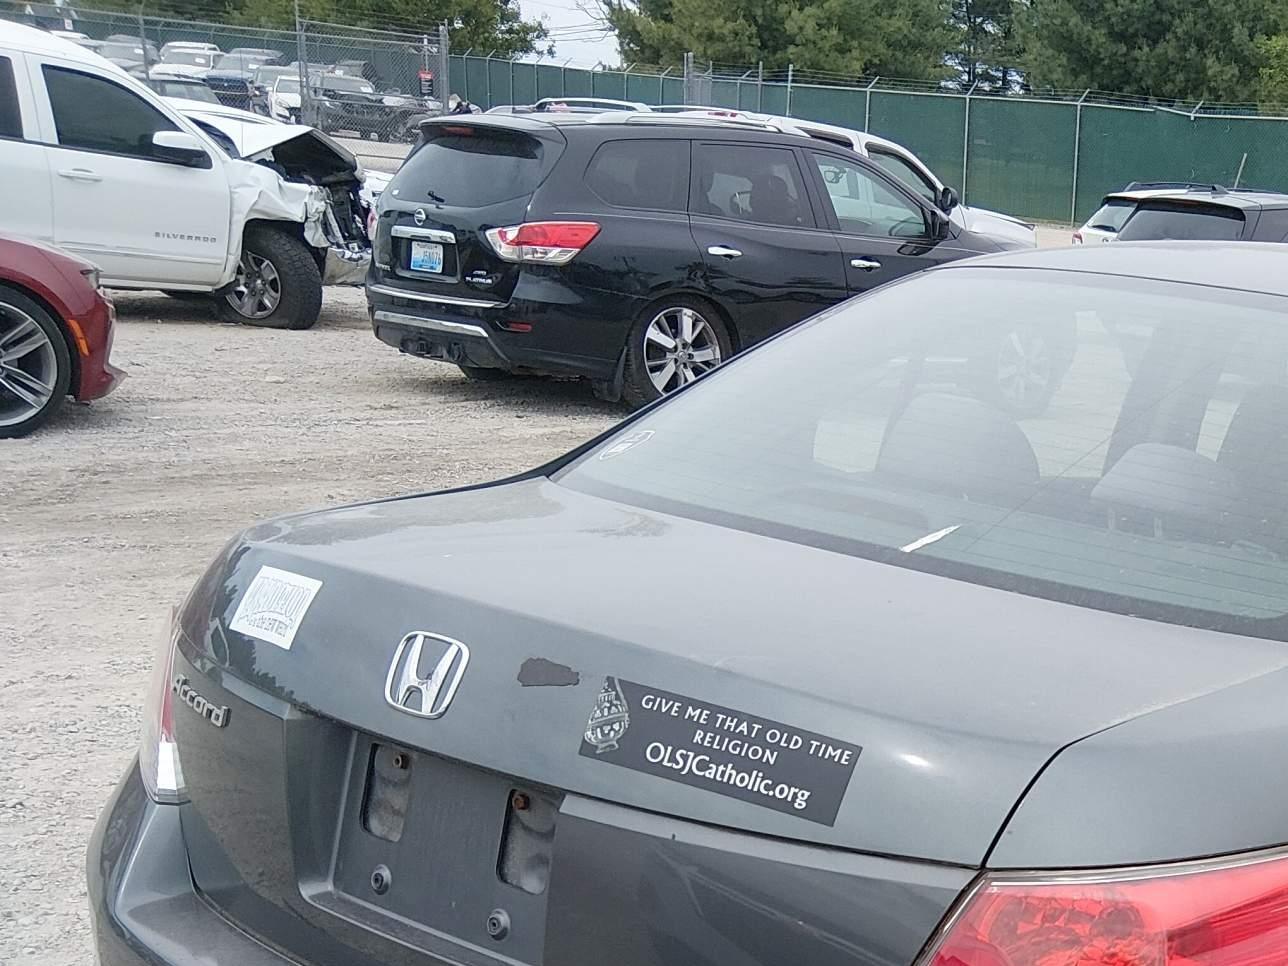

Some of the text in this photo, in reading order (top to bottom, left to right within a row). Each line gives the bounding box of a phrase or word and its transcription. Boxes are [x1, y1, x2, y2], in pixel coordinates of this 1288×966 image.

[154, 231, 217, 243] SILVERADO
[173, 673, 231, 728] Accord
[641, 694, 853, 766] GIVE ME THAT OLD TIME
[692, 729, 778, 766] RELIGION
[645, 741, 811, 809] OLSJCatholic.org
